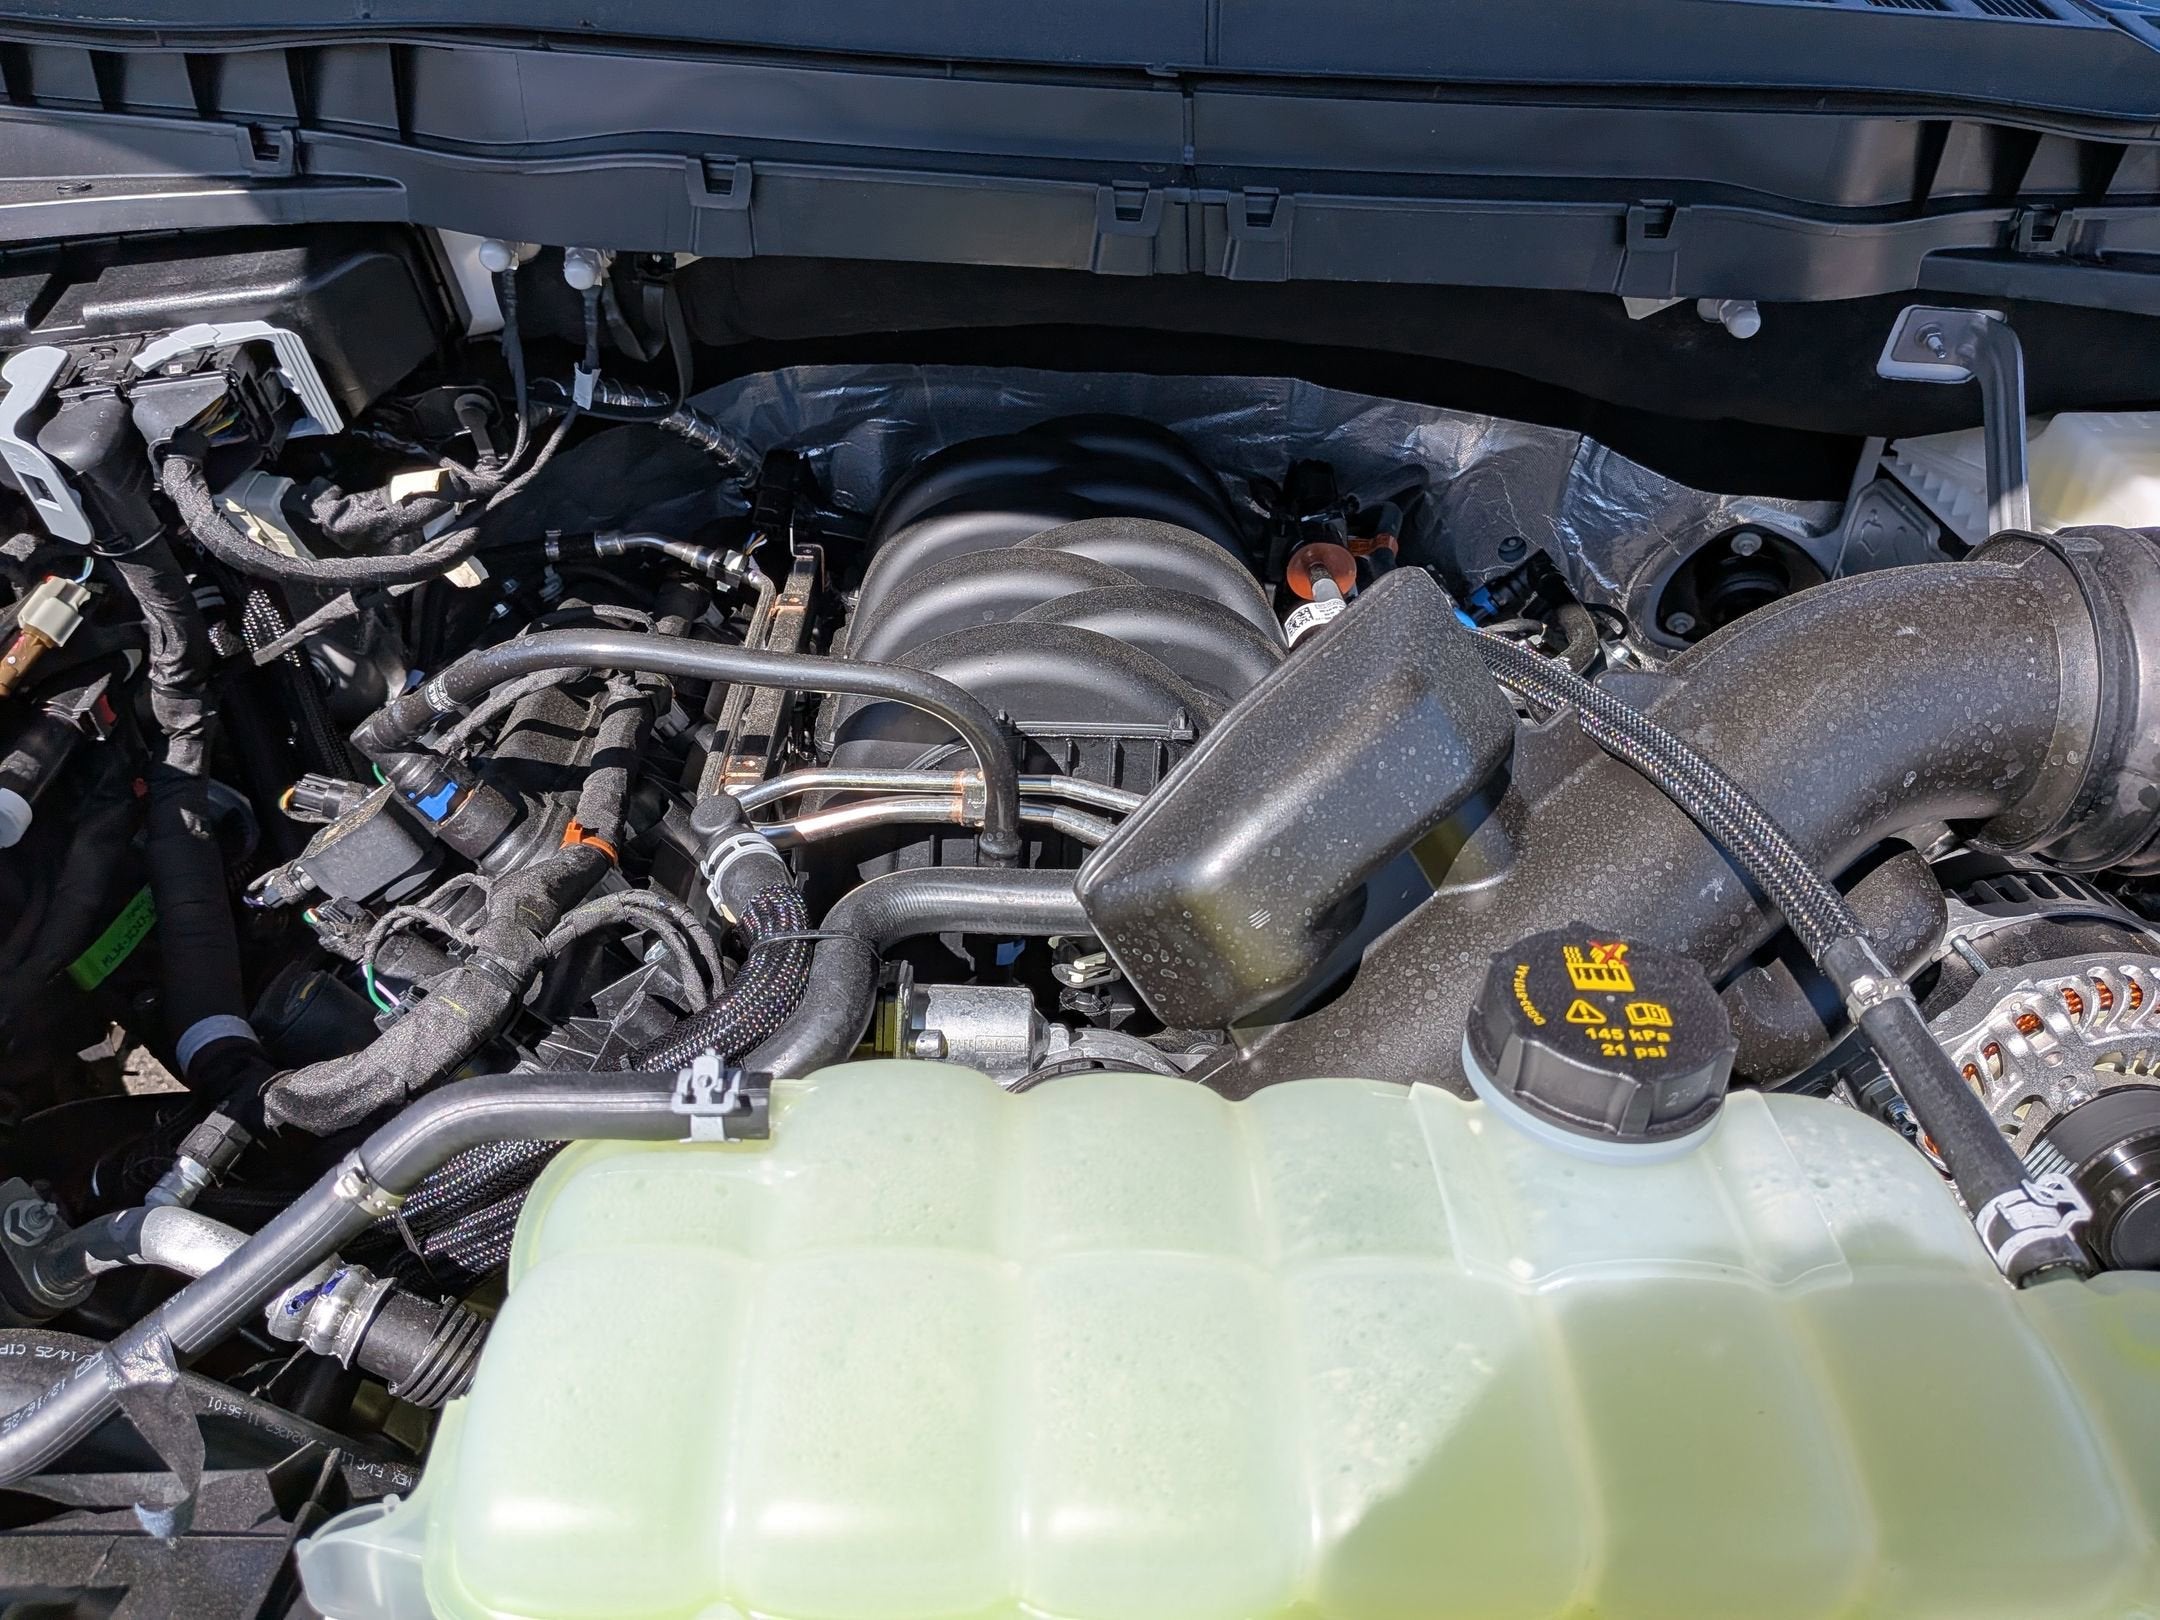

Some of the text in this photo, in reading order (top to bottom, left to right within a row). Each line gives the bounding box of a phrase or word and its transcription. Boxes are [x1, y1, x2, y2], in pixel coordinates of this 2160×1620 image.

[1584, 1027, 1671, 1043] 145 kPa
[1600, 1043, 1668, 1060] 21 psi
[207, 1396, 260, 1427] 11:56:01
